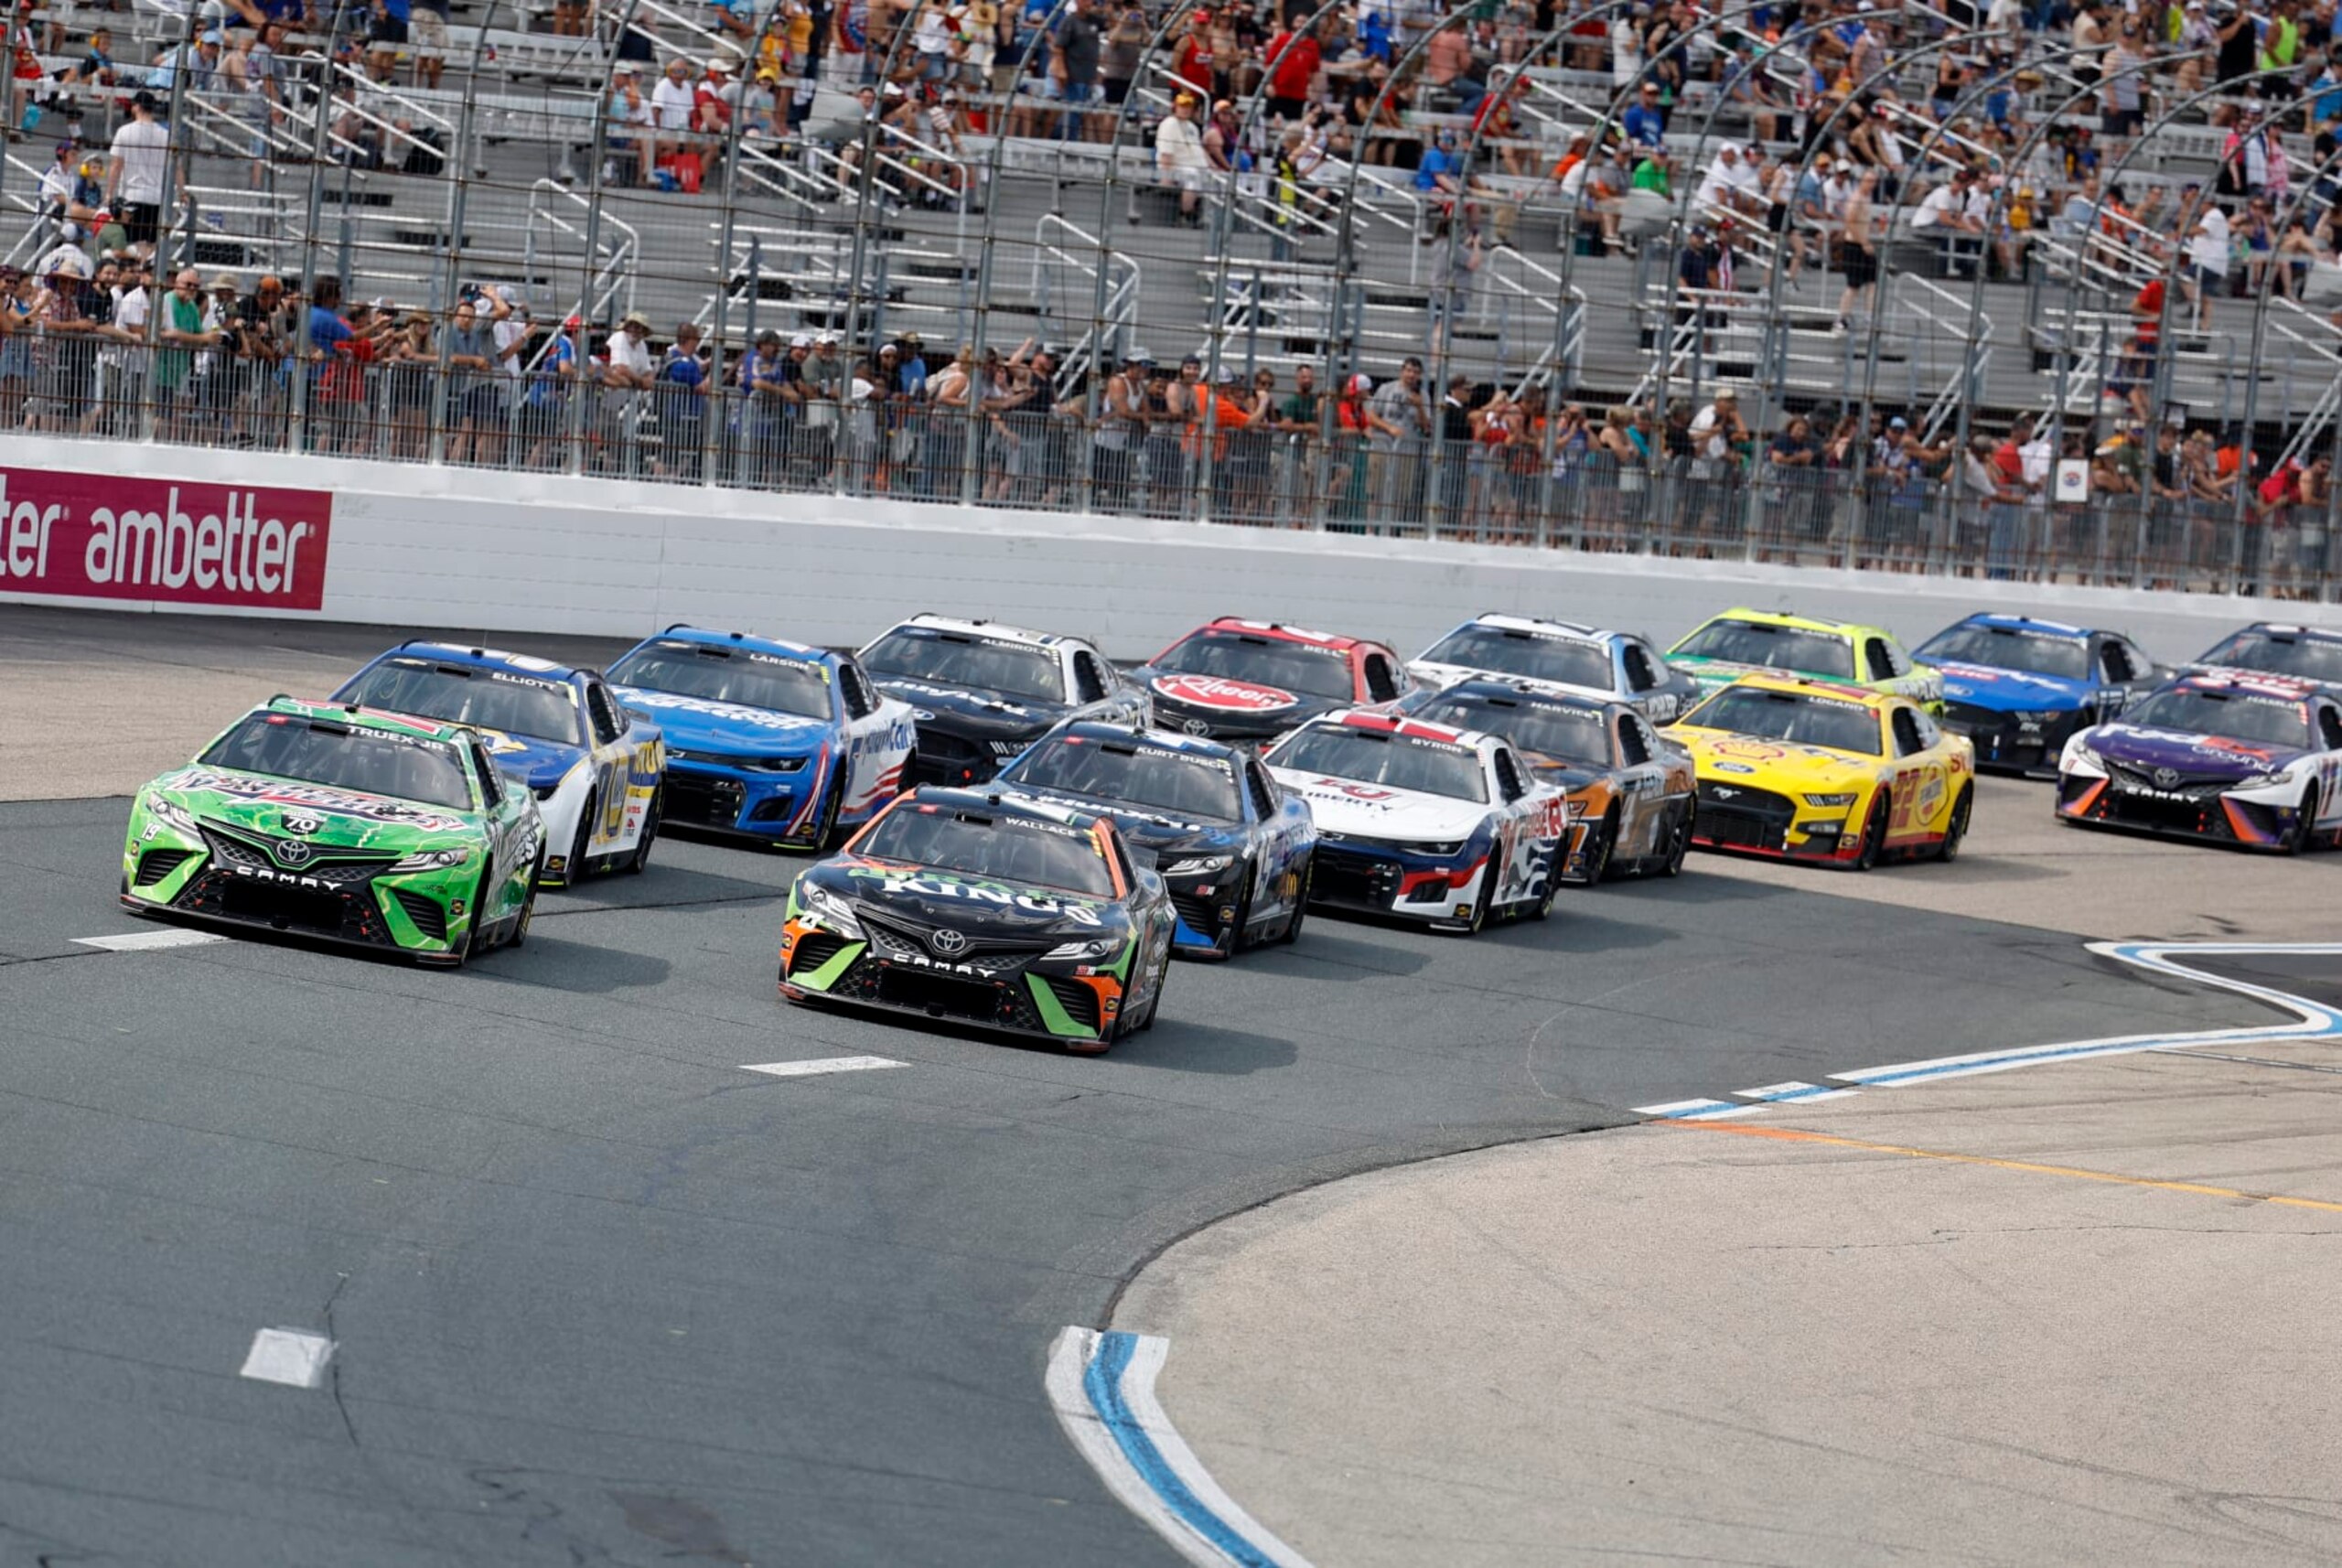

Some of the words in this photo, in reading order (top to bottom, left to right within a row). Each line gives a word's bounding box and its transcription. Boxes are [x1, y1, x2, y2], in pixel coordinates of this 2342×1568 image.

[84, 486, 307, 594] ambetter
[981, 638, 1051, 656] ALMIROLA
[1303, 643, 1342, 660] BELL
[749, 653, 810, 671] LARSON
[492, 671, 557, 691] ELLIOTT
[1531, 702, 1594, 719] HARVICK
[1808, 695, 1864, 713] LOGANO
[347, 725, 414, 746] TRUEX
[1411, 737, 1463, 754] BYRON
[1136, 746, 1177, 759] KURT
[1179, 754, 1224, 769] BUSCH
[2192, 744, 2275, 774] Ground
[2125, 786, 2200, 804] CAMRY
[141, 822, 163, 842] 19
[285, 815, 317, 832] 70
[1005, 816, 1077, 838] WALLACE
[236, 865, 343, 891] CAMRY
[882, 878, 1102, 927] KINGS
[893, 951, 997, 979] CAMRY
